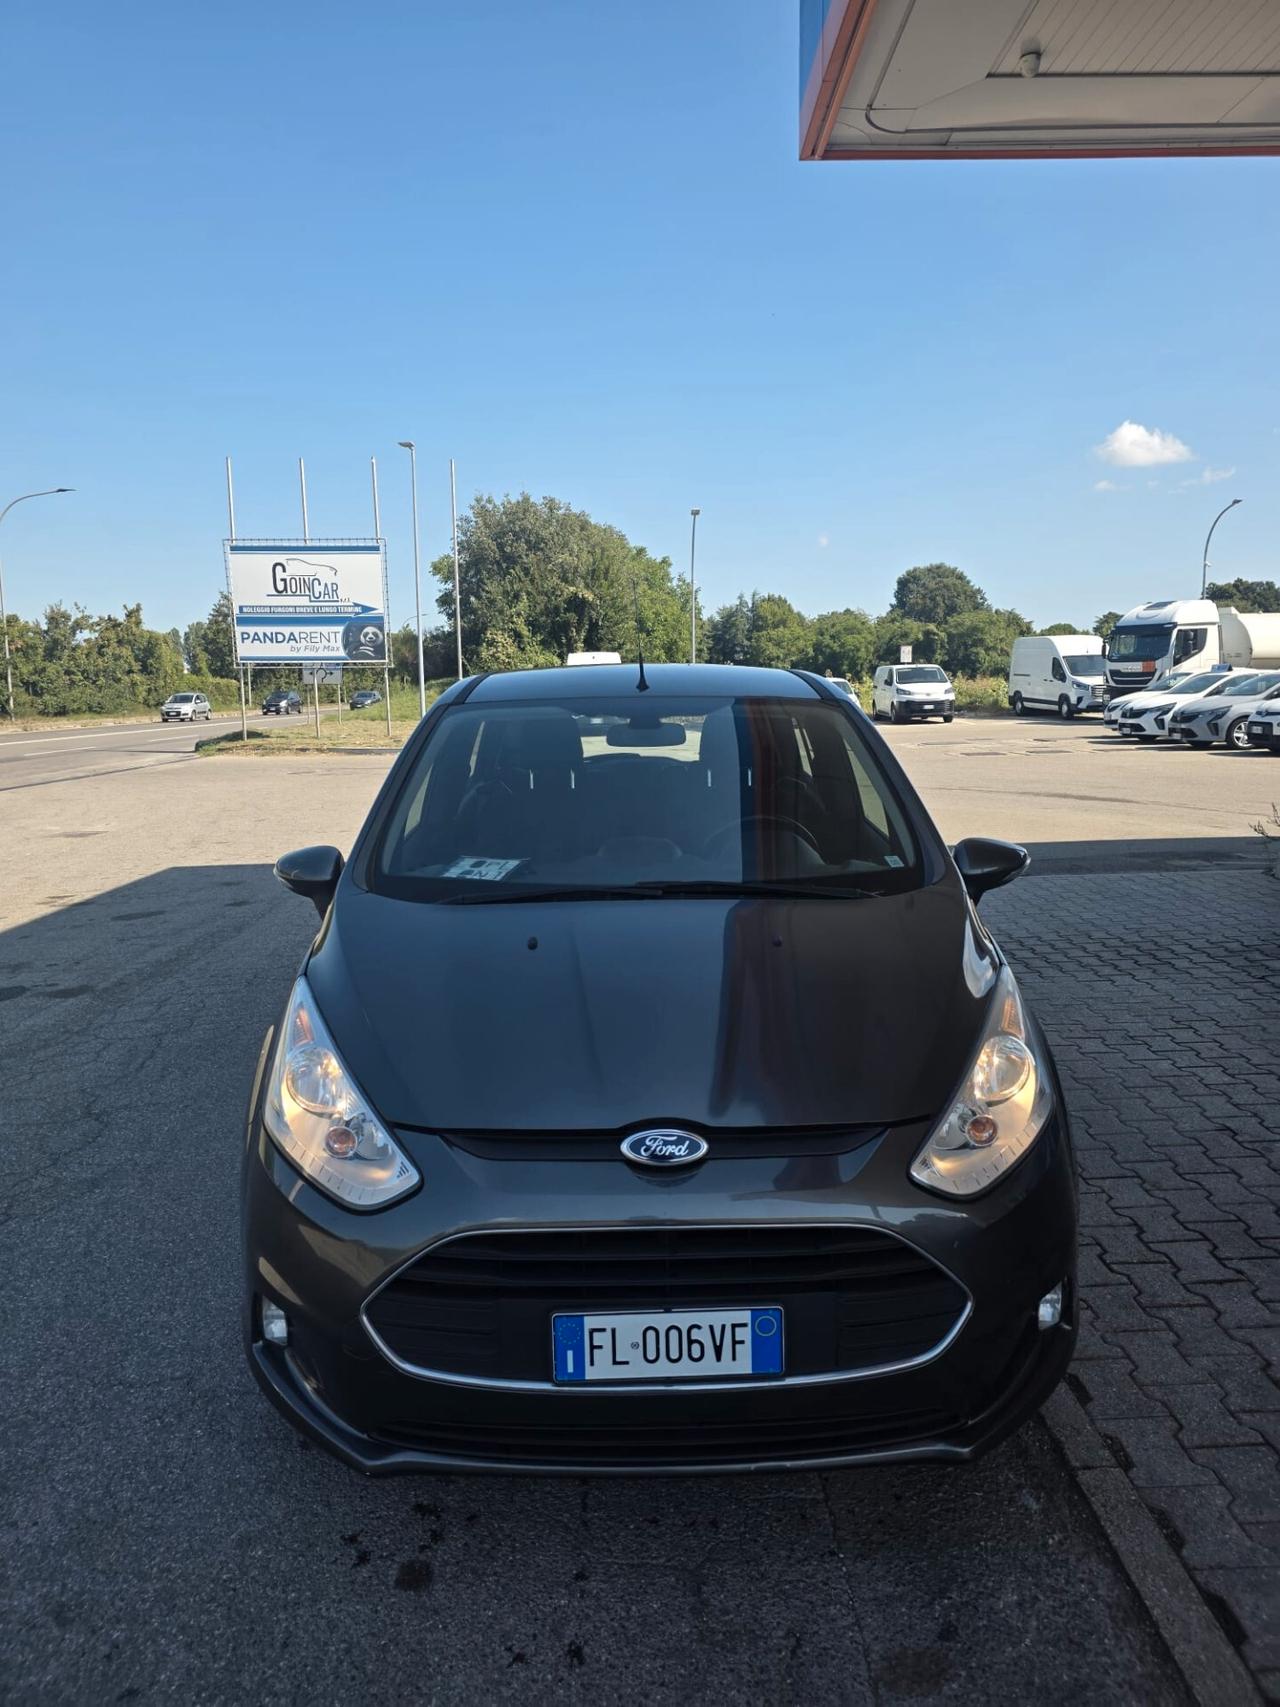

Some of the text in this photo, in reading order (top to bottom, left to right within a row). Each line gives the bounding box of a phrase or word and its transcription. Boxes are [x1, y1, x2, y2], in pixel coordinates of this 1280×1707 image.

[240, 631, 340, 644] PANDARENT
[290, 645, 301, 653] by
[640, 1135, 690, 1157] Ford
